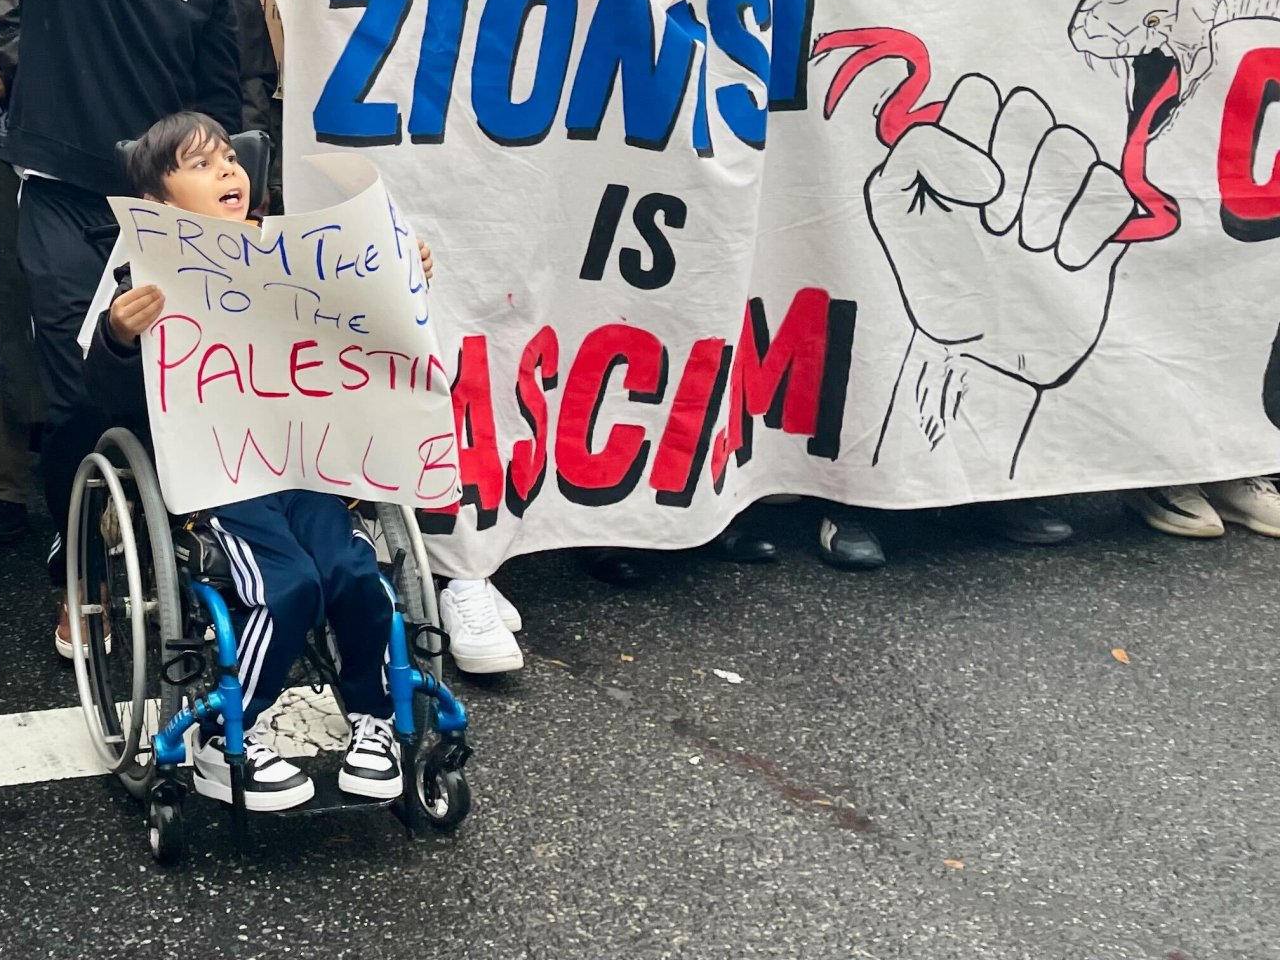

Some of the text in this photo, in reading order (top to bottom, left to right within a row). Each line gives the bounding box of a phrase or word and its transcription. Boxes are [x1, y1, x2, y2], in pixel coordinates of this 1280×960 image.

[128, 208, 291, 276] FROM
[579, 183, 687, 290] IS
[150, 314, 448, 413] PALESTIN
[212, 420, 399, 491] WILL
